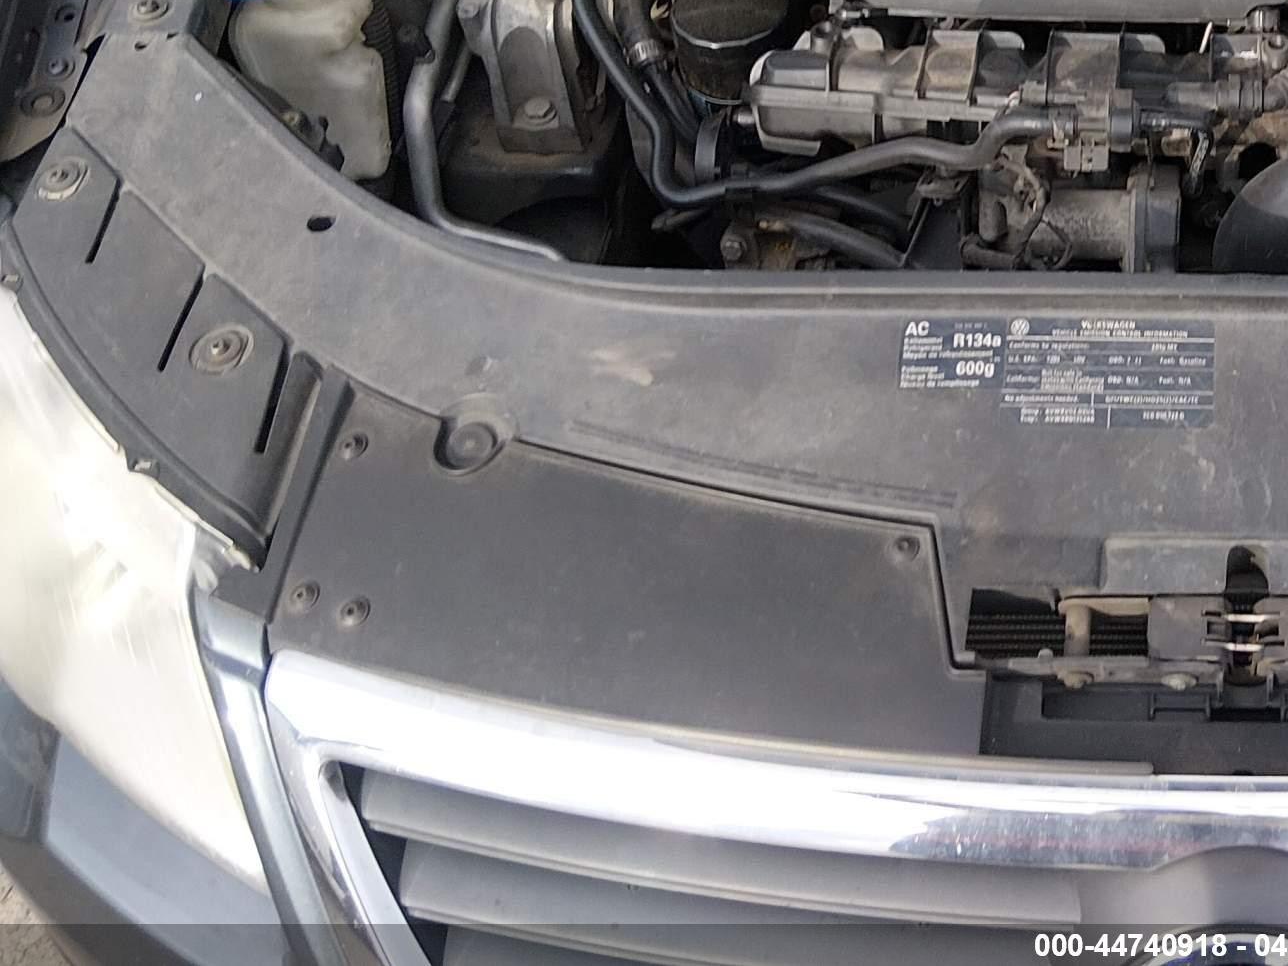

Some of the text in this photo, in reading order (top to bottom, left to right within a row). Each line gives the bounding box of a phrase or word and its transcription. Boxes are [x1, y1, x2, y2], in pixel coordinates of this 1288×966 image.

[905, 320, 930, 336] AC
[953, 332, 1002, 348] R134a
[956, 361, 995, 378] 600g
